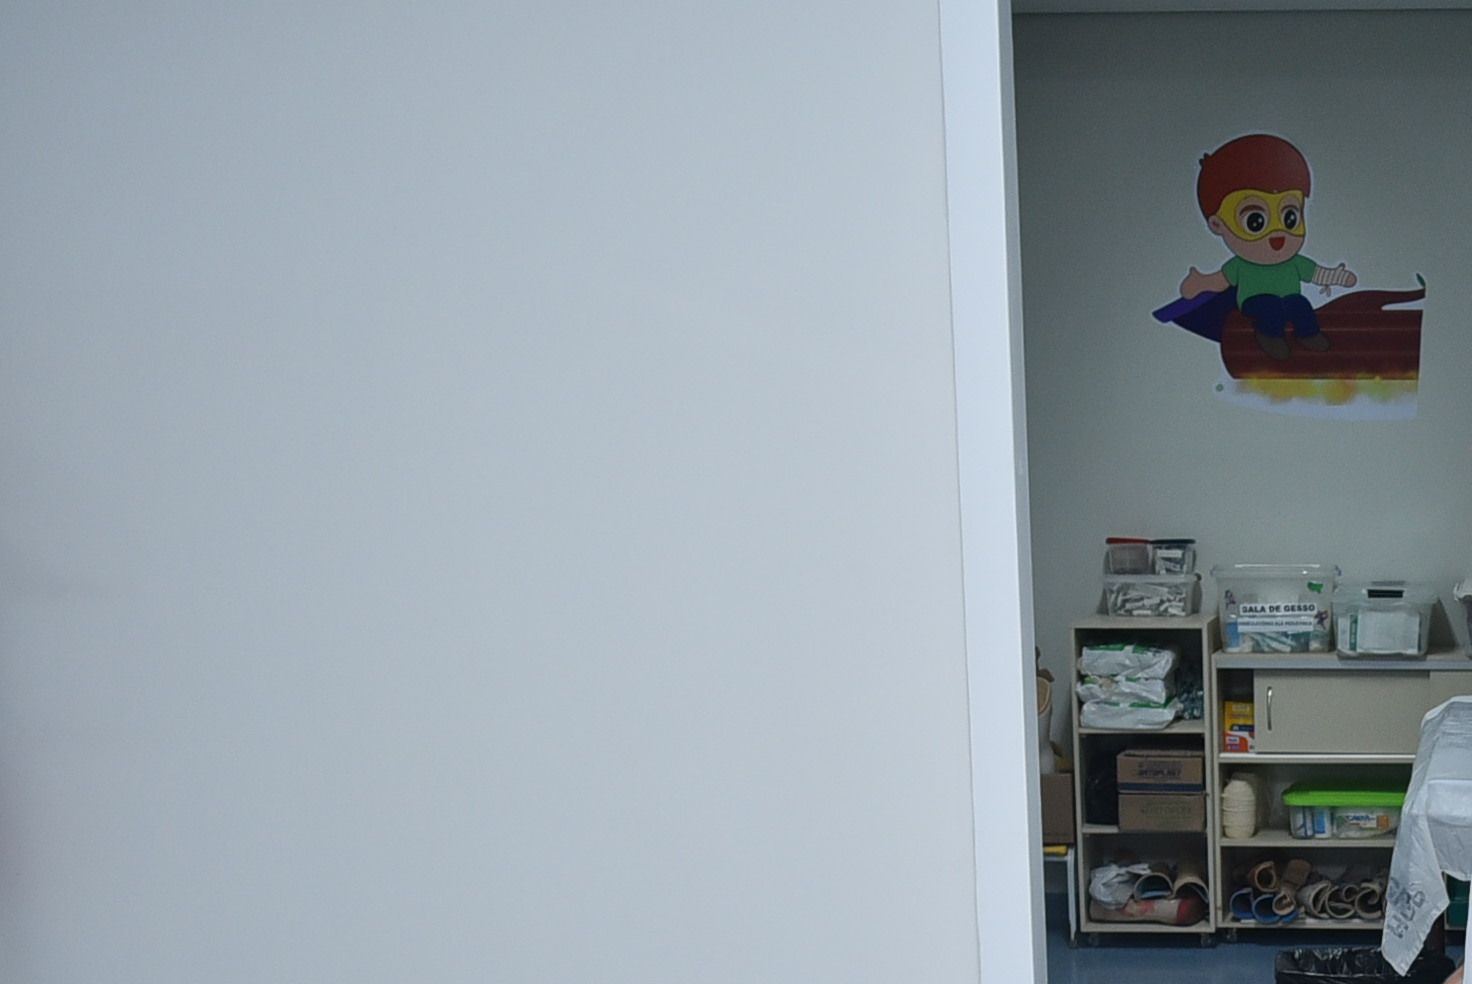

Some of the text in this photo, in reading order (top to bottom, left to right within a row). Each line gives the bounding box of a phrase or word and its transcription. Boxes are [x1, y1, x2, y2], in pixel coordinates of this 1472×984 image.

[1242, 604, 1316, 613] SALA DE GESSO
